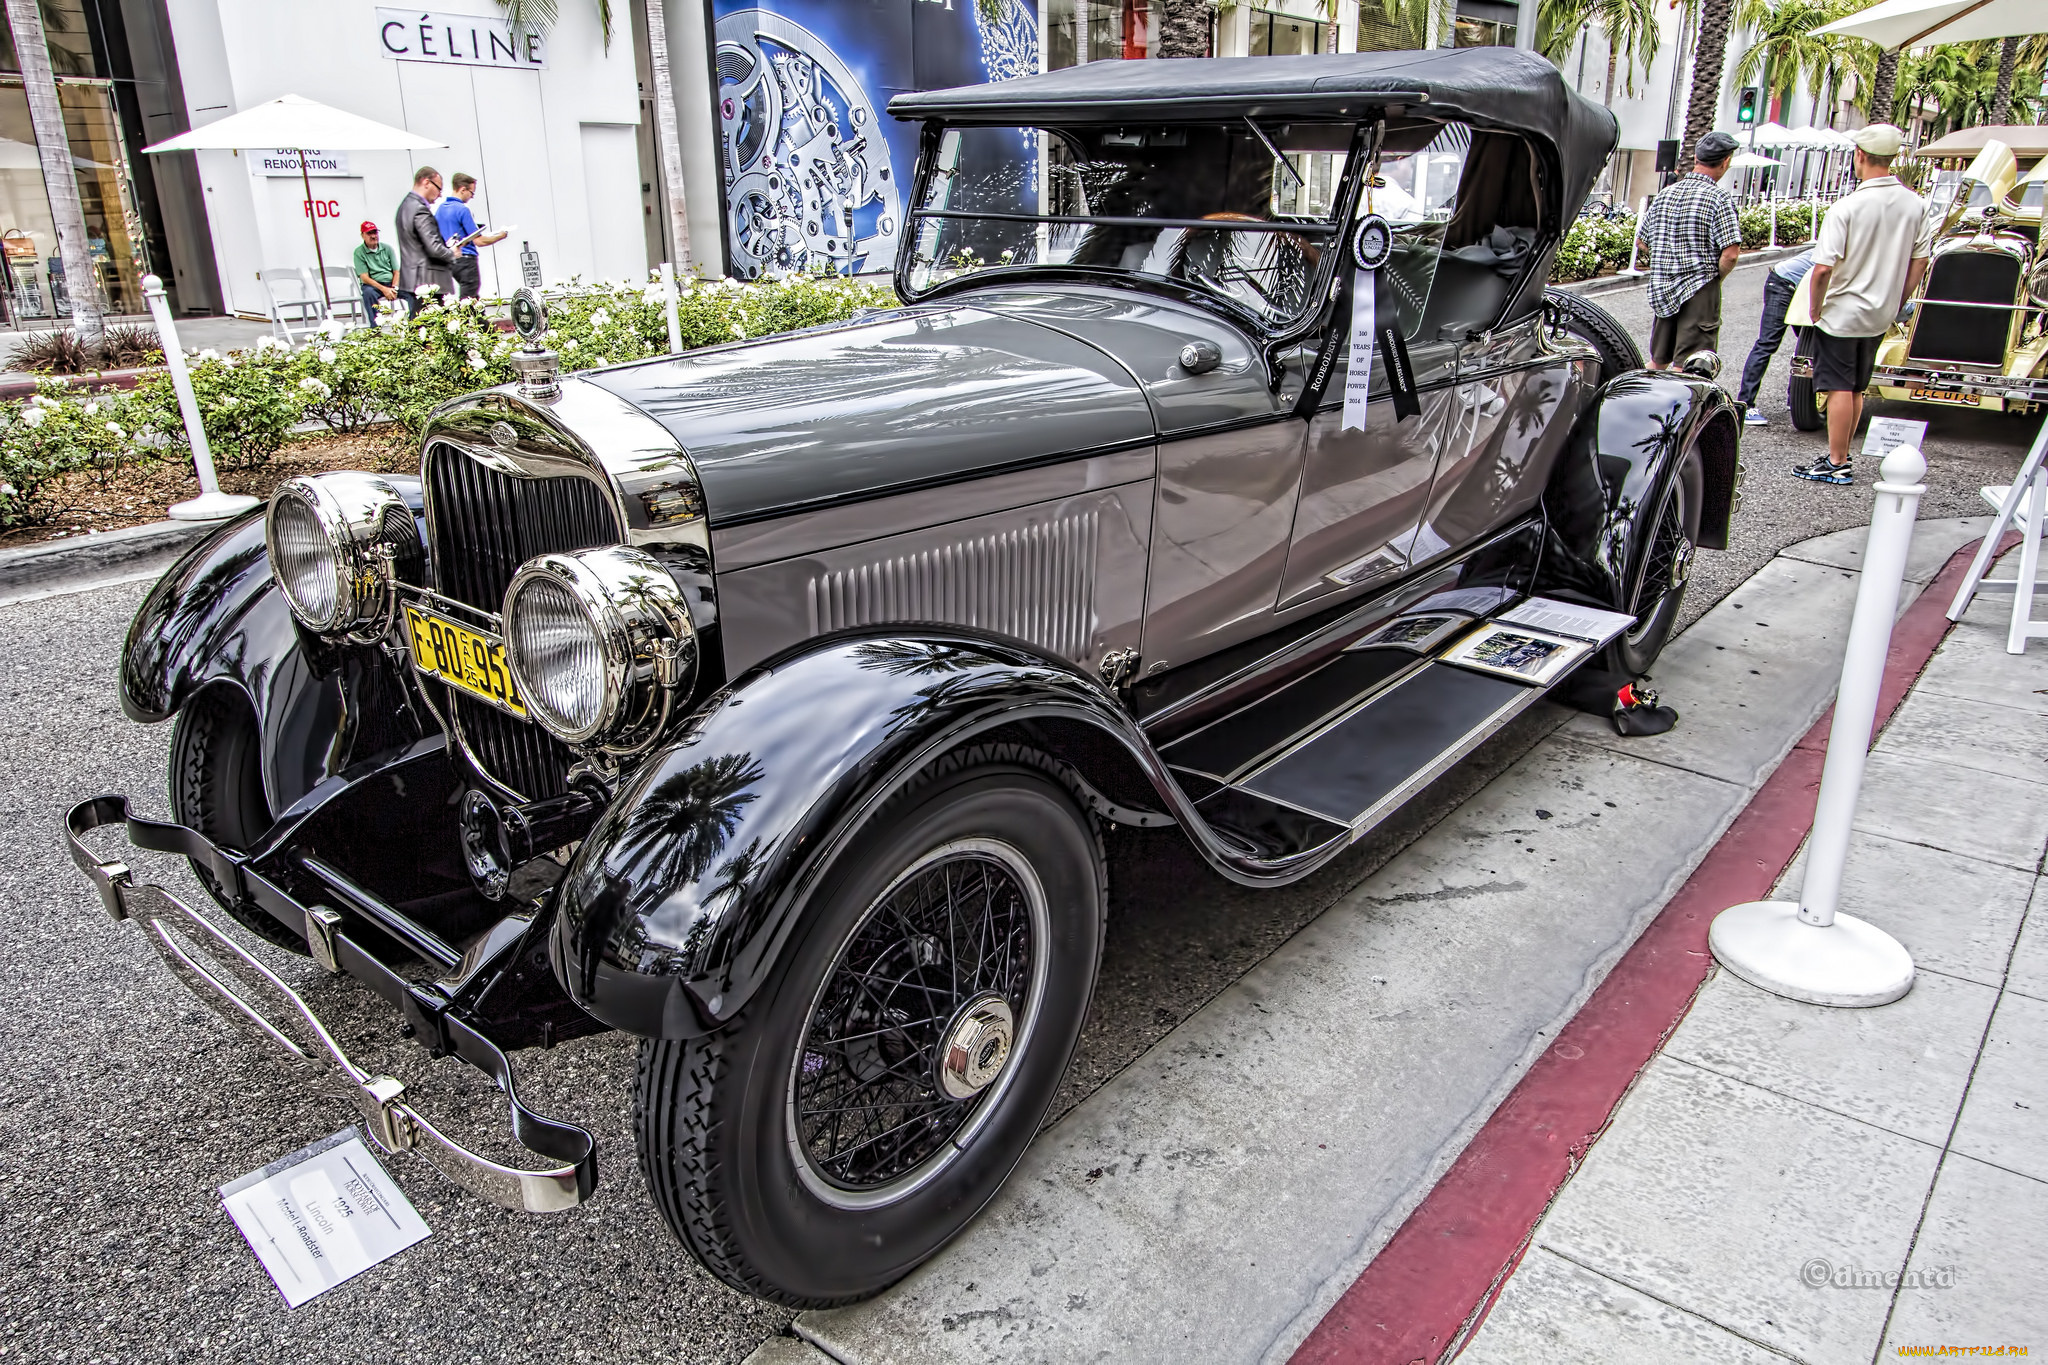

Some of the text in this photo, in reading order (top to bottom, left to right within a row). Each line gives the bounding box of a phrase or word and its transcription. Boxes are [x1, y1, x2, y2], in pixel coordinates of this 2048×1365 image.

[381, 14, 543, 64] CÉLINE
[263, 159, 337, 170] RENOVATION
[303, 200, 340, 218] FDC
[1353, 343, 1371, 351] YEARS
[464, 668, 479, 688] 25
[305, 1200, 334, 1235] Lincoln
[332, 1196, 354, 1218] 1925
[276, 1197, 323, 1259] Model L-Roadster
